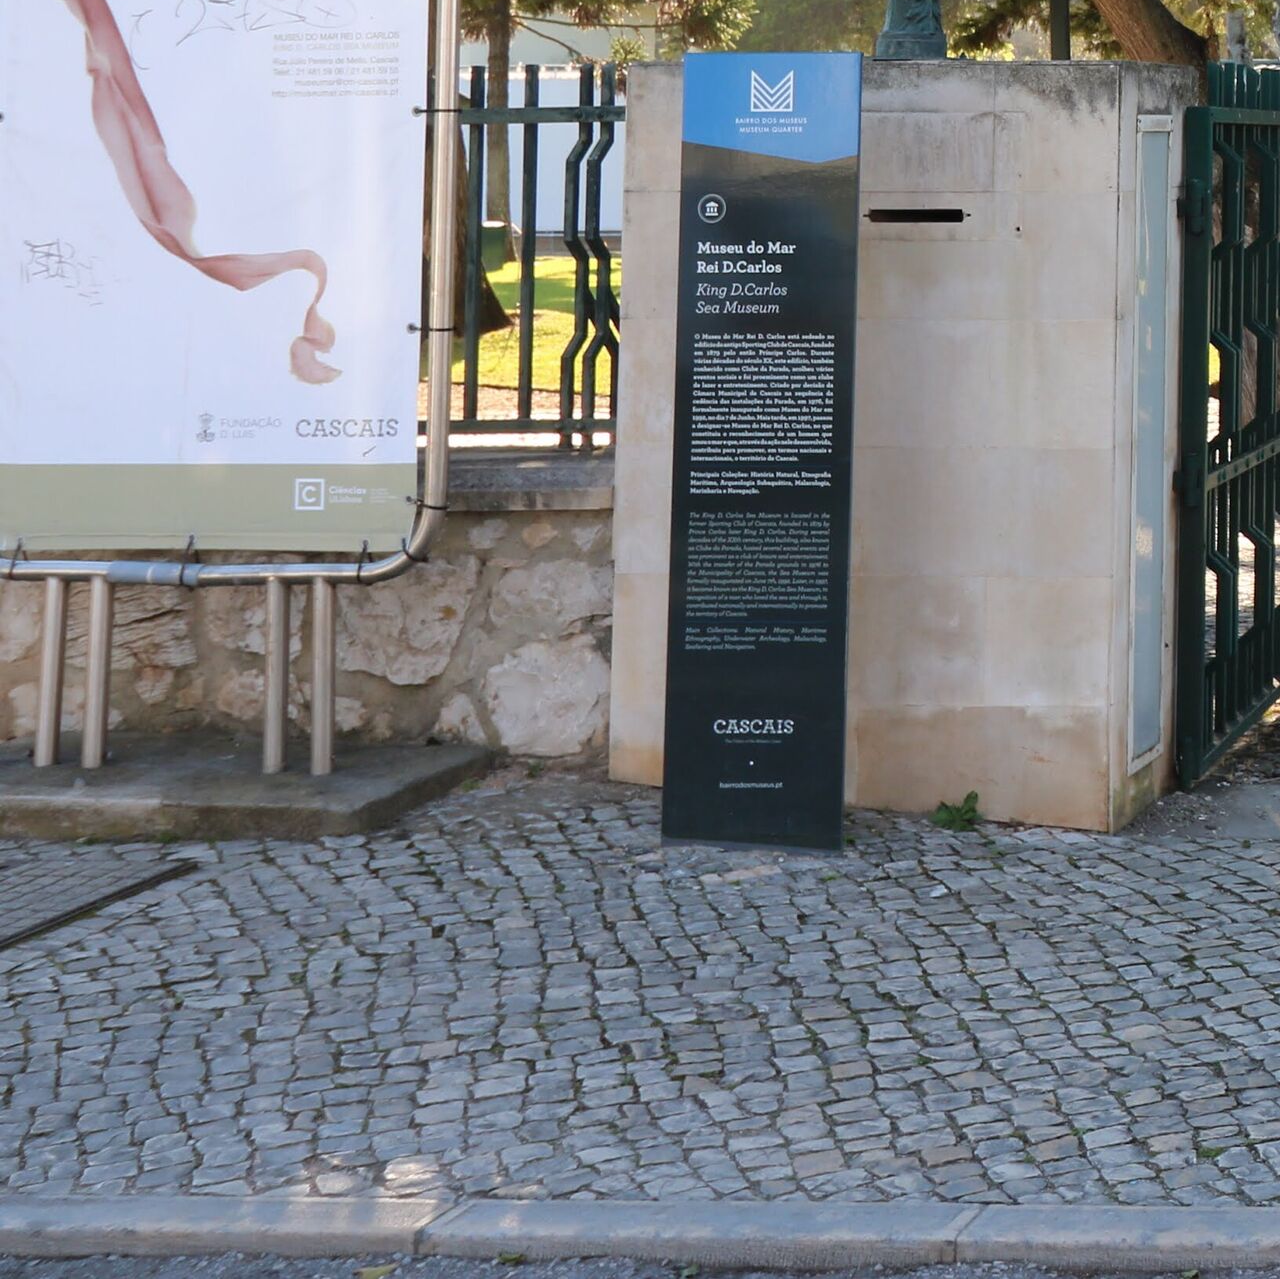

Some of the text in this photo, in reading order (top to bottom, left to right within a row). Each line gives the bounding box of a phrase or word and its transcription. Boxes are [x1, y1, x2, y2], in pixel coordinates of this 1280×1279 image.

[697, 242, 796, 254] Museu do Mar
[697, 261, 782, 273] Rei D.Carlos
[696, 283, 788, 297] King D.Carlos
[696, 302, 780, 314] Sea Museum
[295, 418, 399, 437] CASCAIS
[713, 719, 794, 734] CASCAIS
